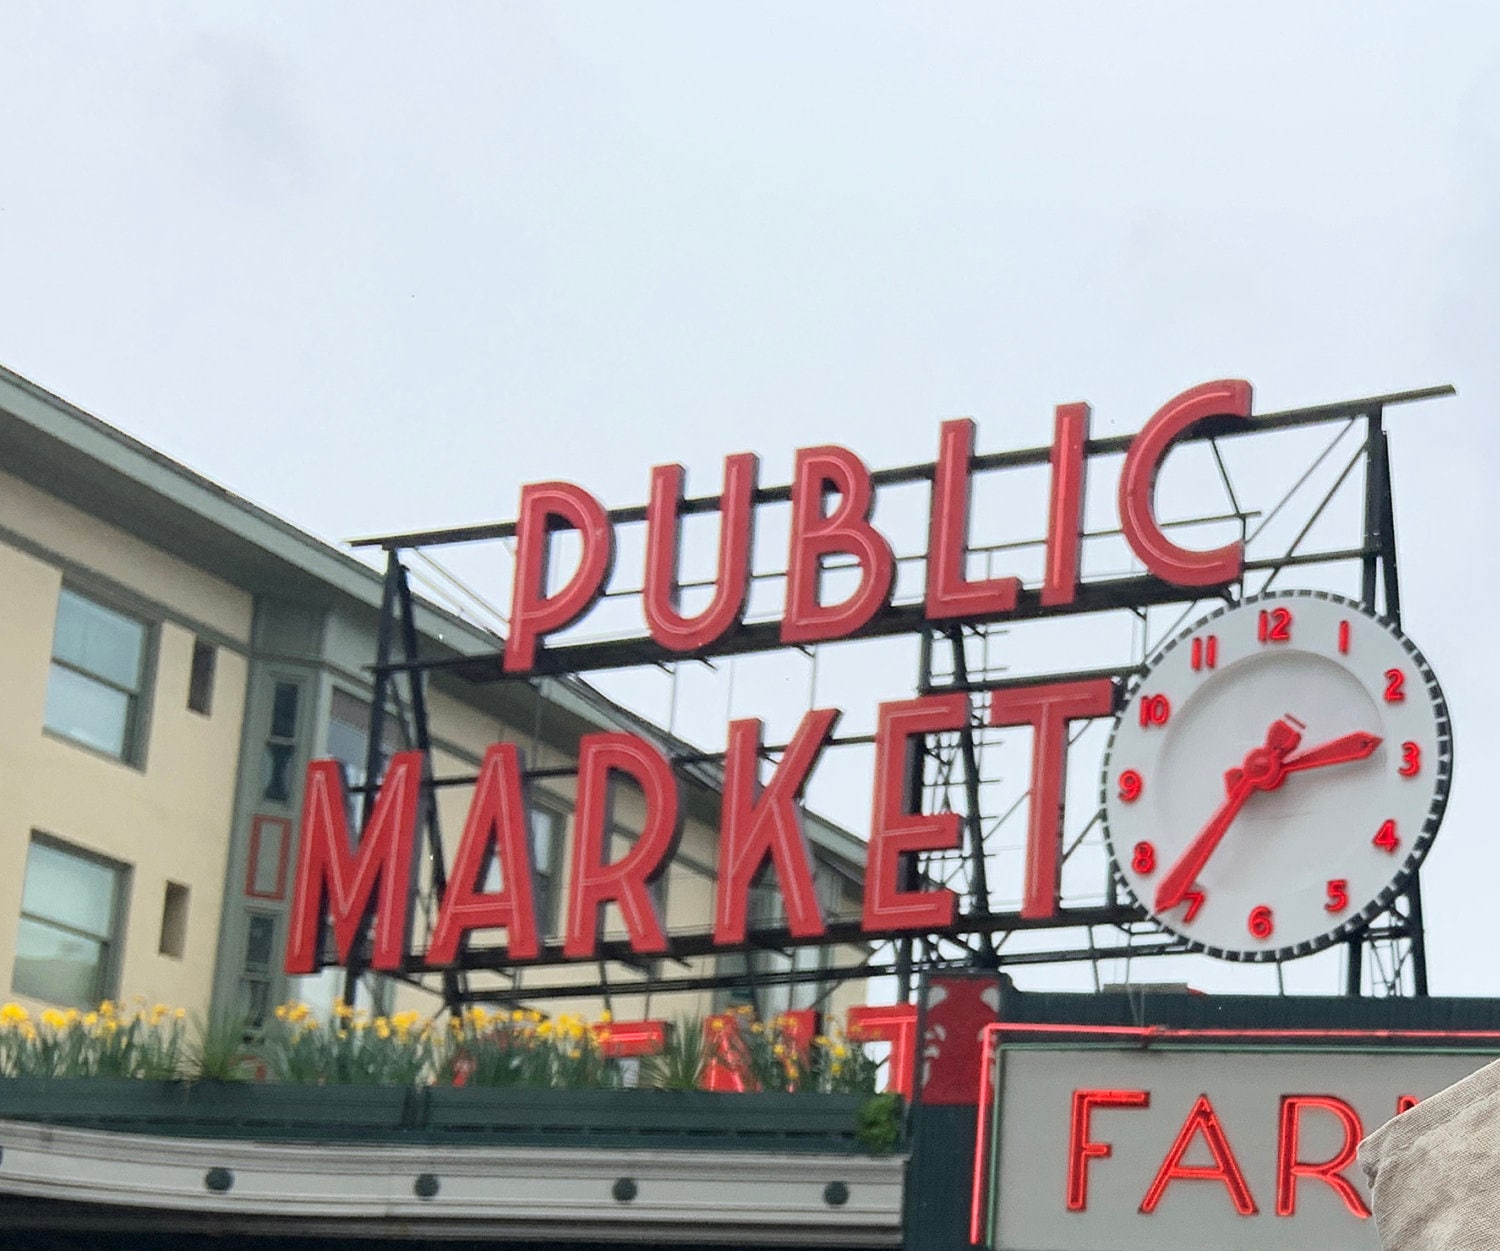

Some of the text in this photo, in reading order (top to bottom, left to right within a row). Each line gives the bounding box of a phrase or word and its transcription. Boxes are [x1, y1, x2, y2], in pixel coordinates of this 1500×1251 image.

[504, 379, 1254, 673] PUBLIC
[1258, 607, 1292, 643] 12
[1338, 620, 1350, 655] 1
[1191, 635, 1217, 671] 11
[1384, 669, 1406, 704] 2
[1139, 694, 1170, 728] 10
[1398, 742, 1421, 778] 3
[1118, 769, 1143, 803] 9
[285, 678, 1116, 976] MARKET
[1372, 819, 1400, 854] 4
[1131, 841, 1156, 875] 8
[1180, 889, 1206, 924] 7
[1324, 880, 1348, 912] 5
[1248, 905, 1274, 939] 6
[1066, 1089, 1420, 1218] FAR
